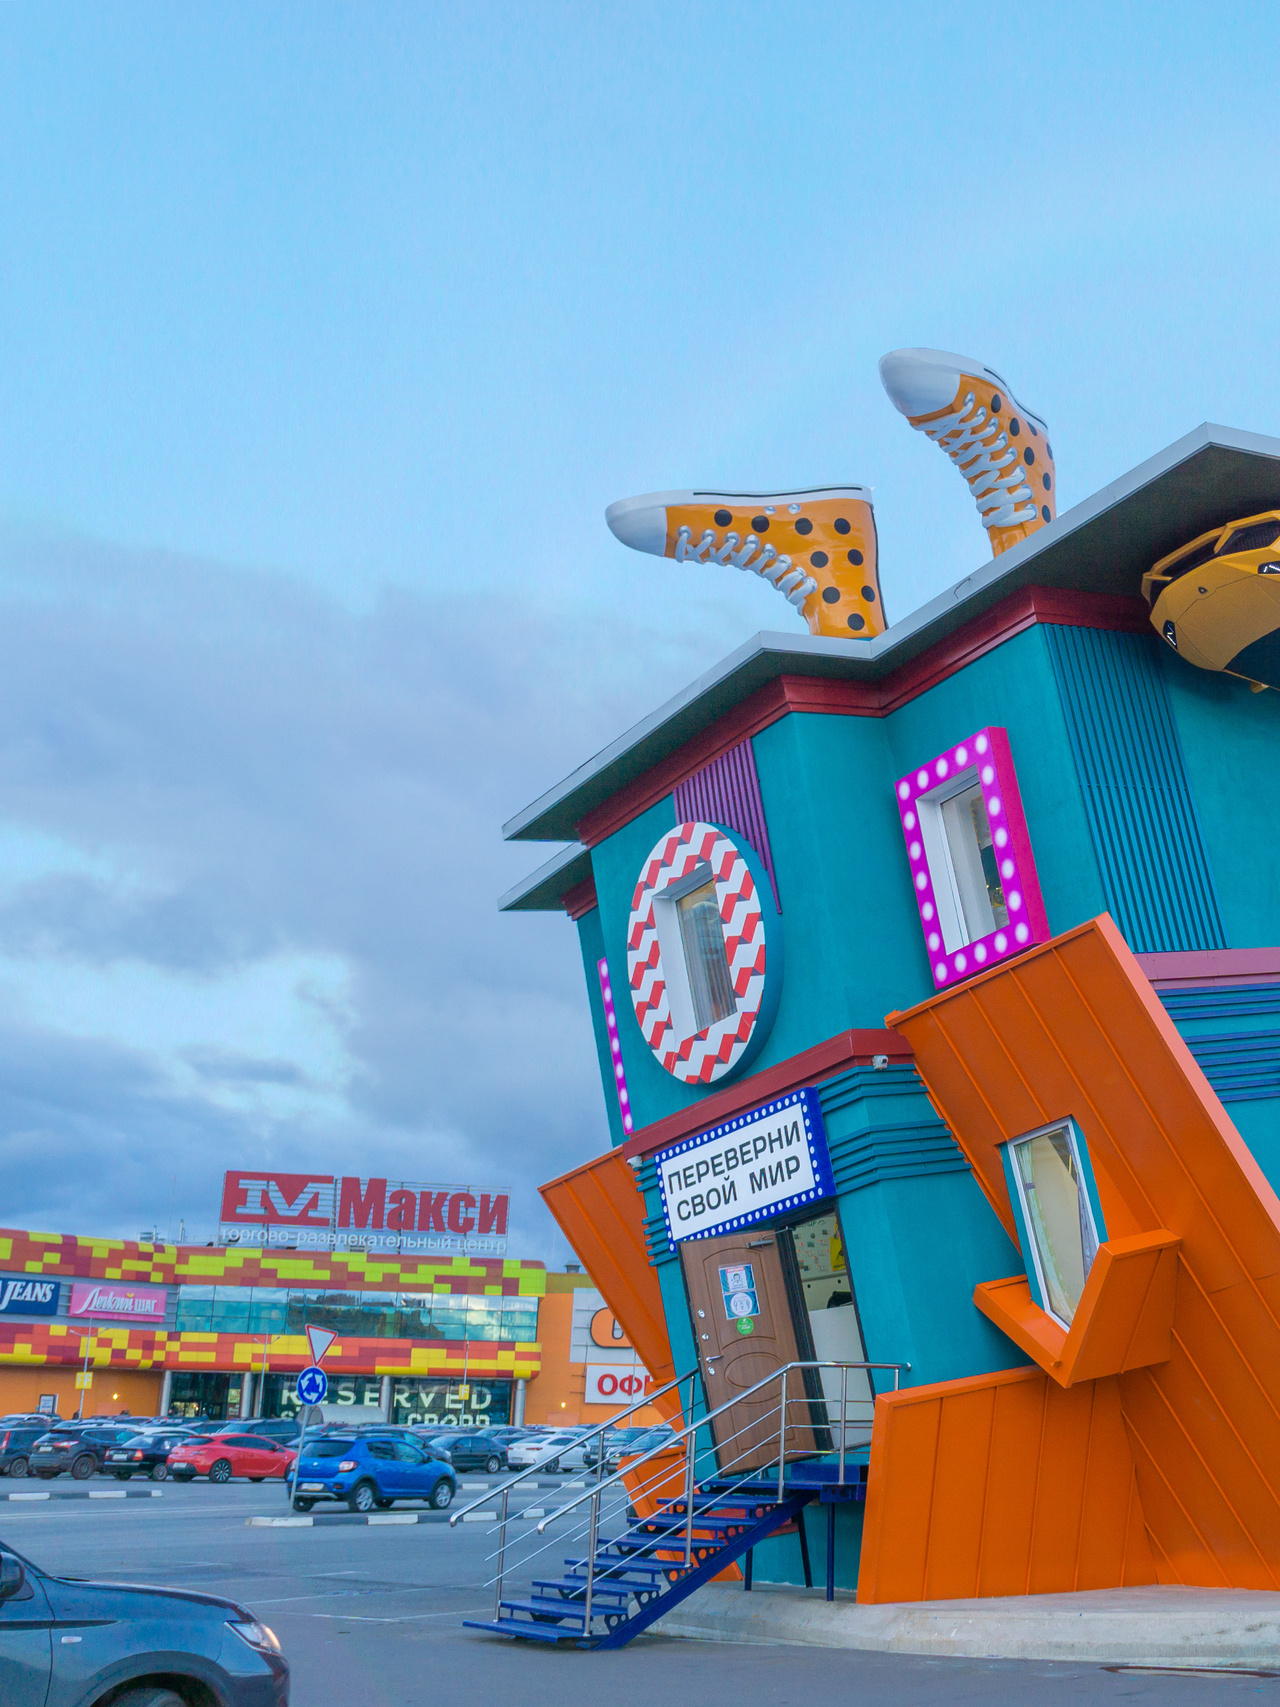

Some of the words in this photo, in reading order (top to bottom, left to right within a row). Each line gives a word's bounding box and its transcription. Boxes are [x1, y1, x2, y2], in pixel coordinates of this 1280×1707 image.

[668, 1120, 801, 1195] ПЕРЕВЕРНИ
[338, 1176, 509, 1235] Макси
[677, 1175, 738, 1222] СВОЙ
[749, 1155, 801, 1195] МИР
[221, 1226, 451, 1250] торгово-развлекательный
[457, 1238, 507, 1255] центр
[0, 1280, 55, 1310] JEANS
[461, 1386, 468, 1398] F
